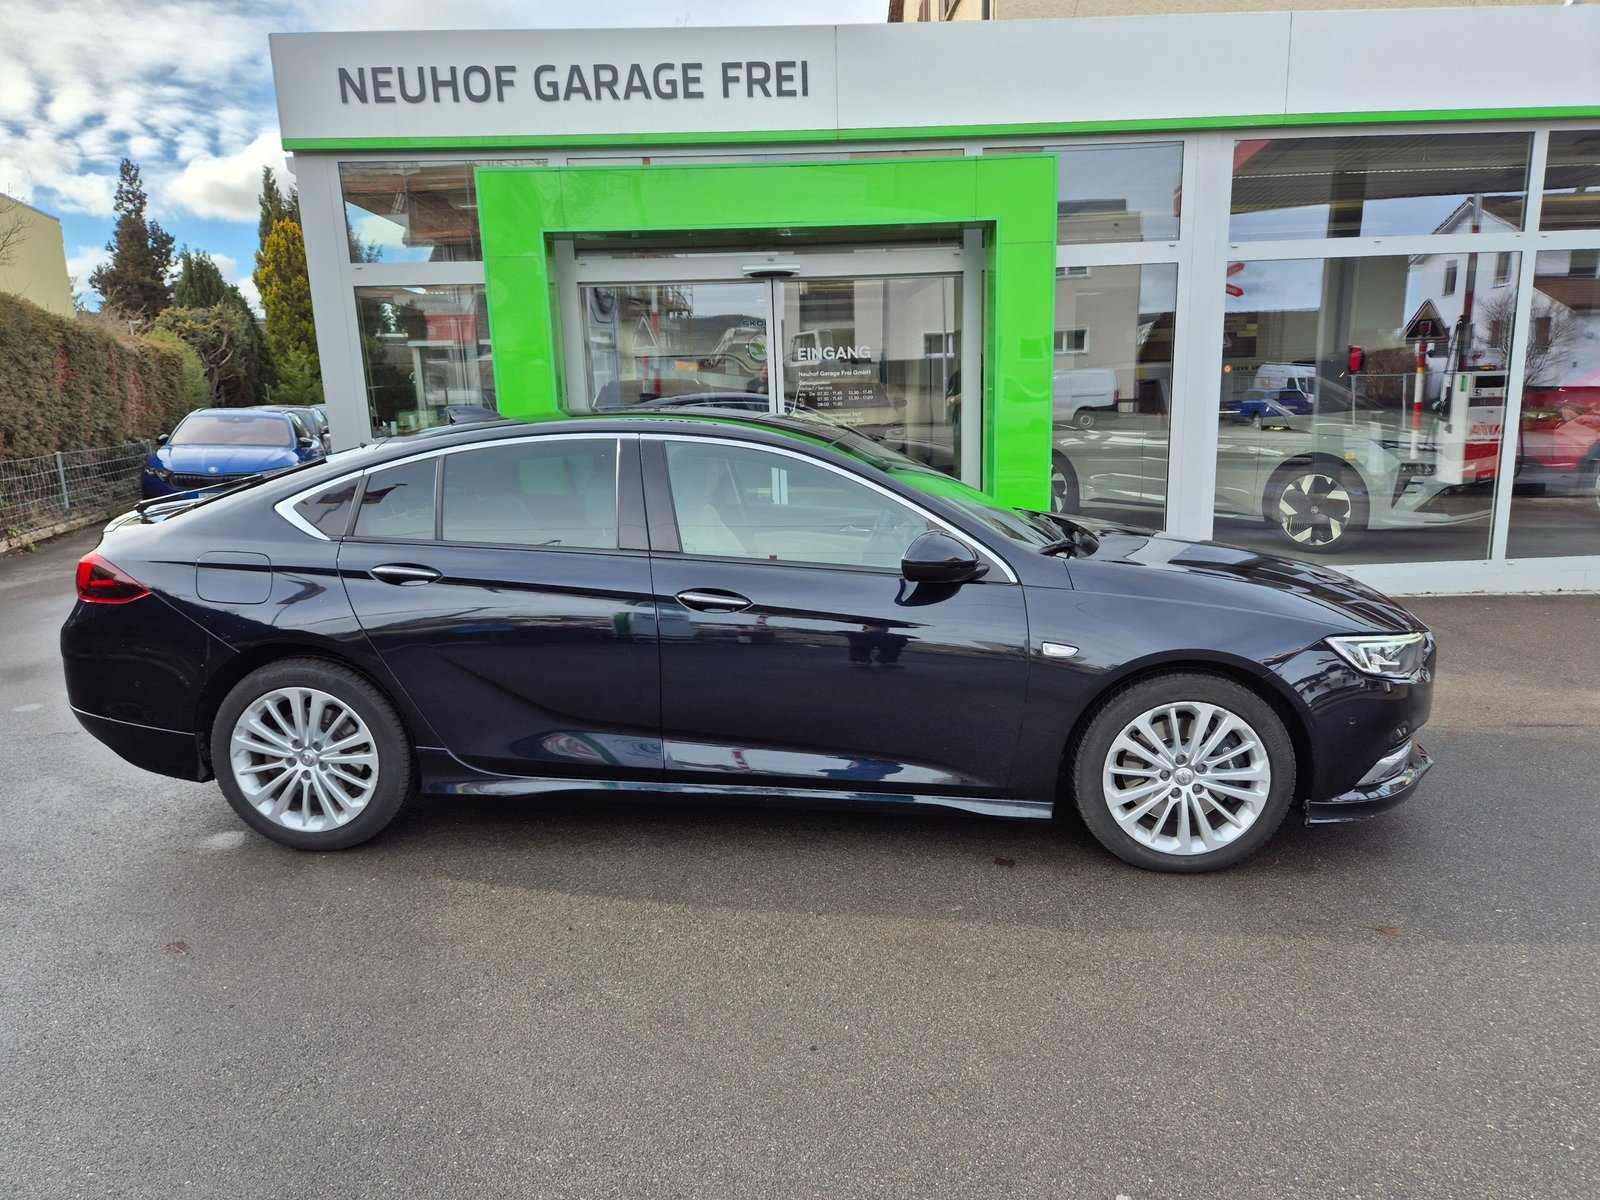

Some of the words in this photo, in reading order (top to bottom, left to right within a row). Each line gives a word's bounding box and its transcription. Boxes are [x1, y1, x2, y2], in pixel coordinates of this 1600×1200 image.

[338, 65, 516, 104] NEUHOF
[533, 62, 704, 103] GARAGE
[721, 60, 809, 99] FREI
[797, 346, 871, 360] EINGANG
